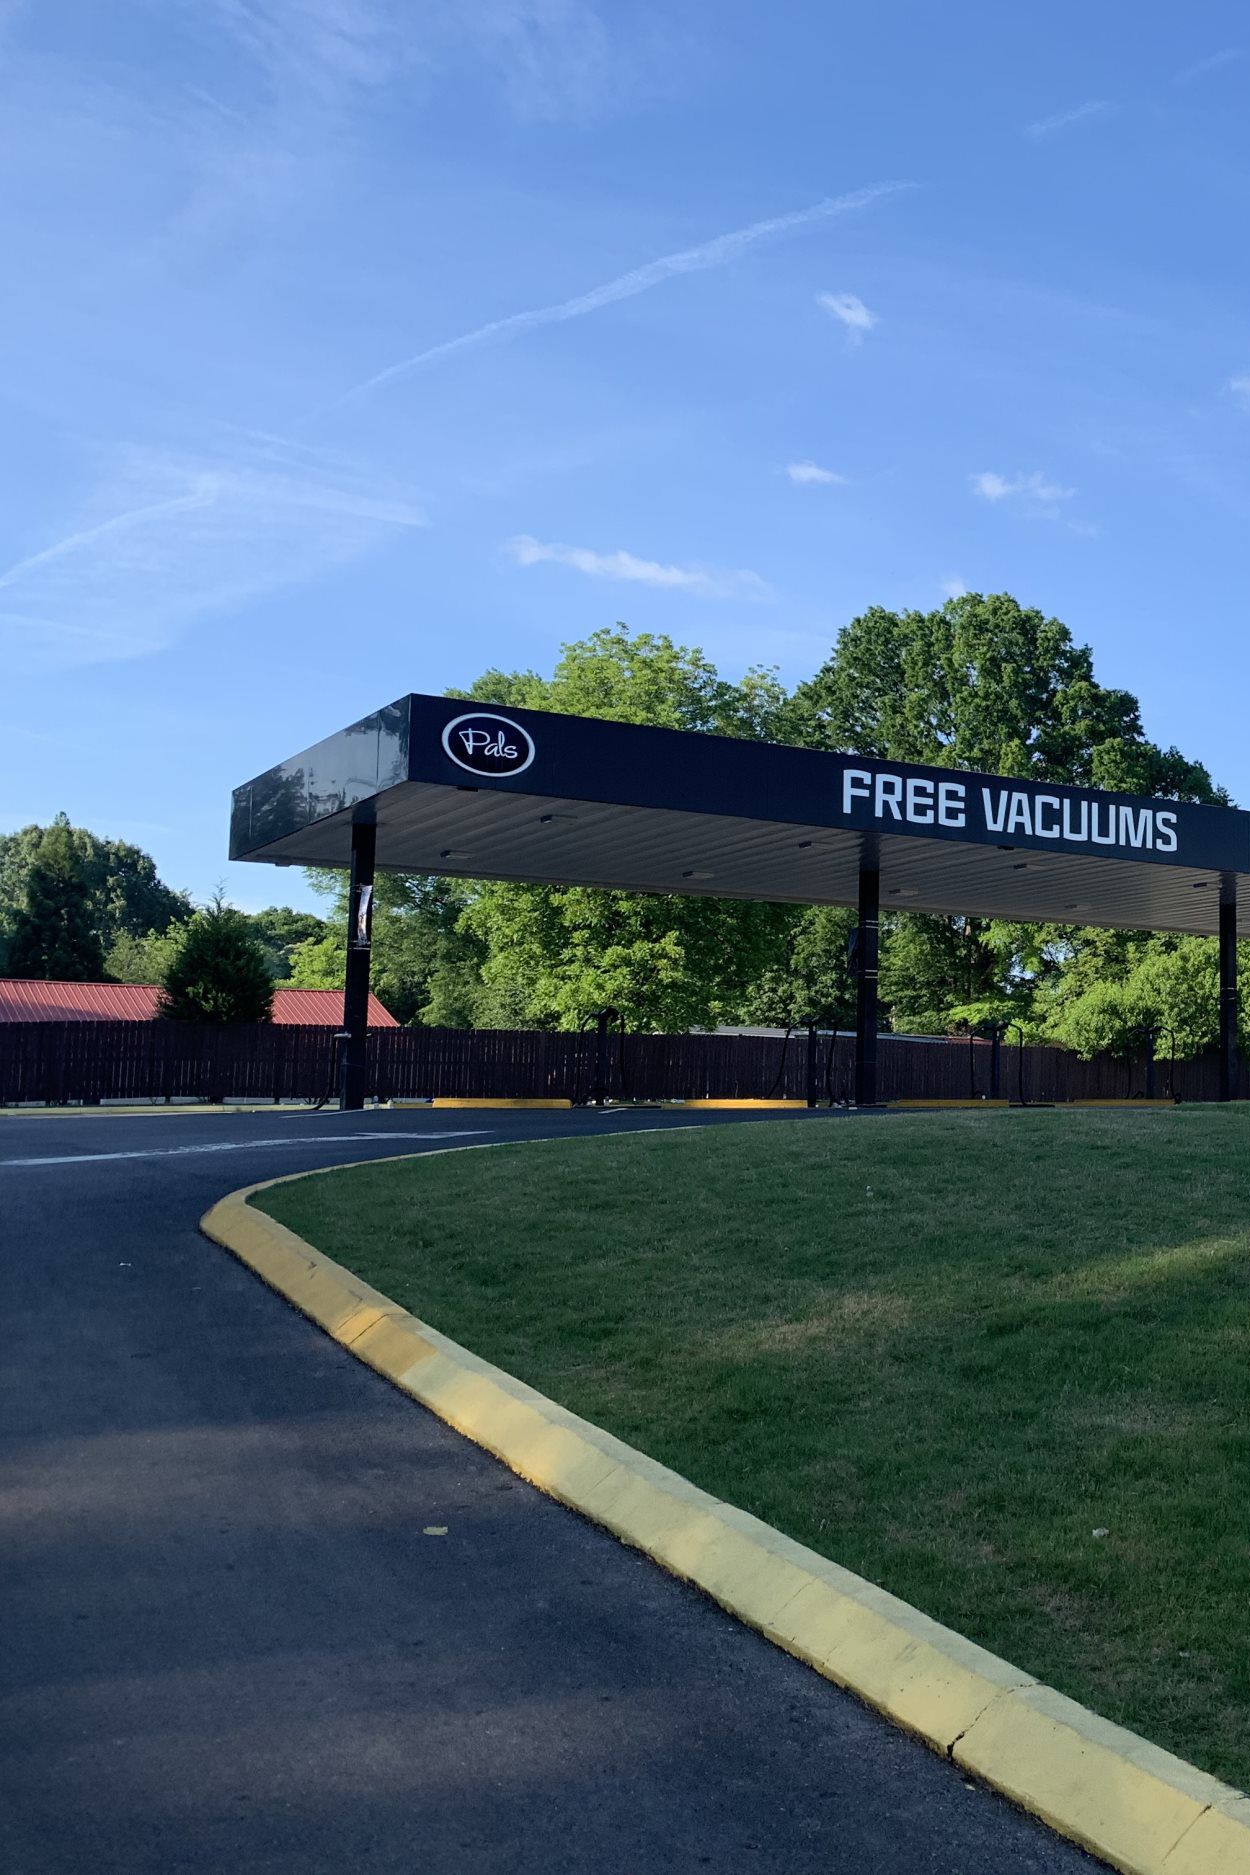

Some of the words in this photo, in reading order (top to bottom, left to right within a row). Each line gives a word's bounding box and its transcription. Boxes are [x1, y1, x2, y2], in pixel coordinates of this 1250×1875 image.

[458, 728, 518, 759] Pals
[843, 769, 965, 827] FREE
[982, 788, 1177, 852] VACUUMS
